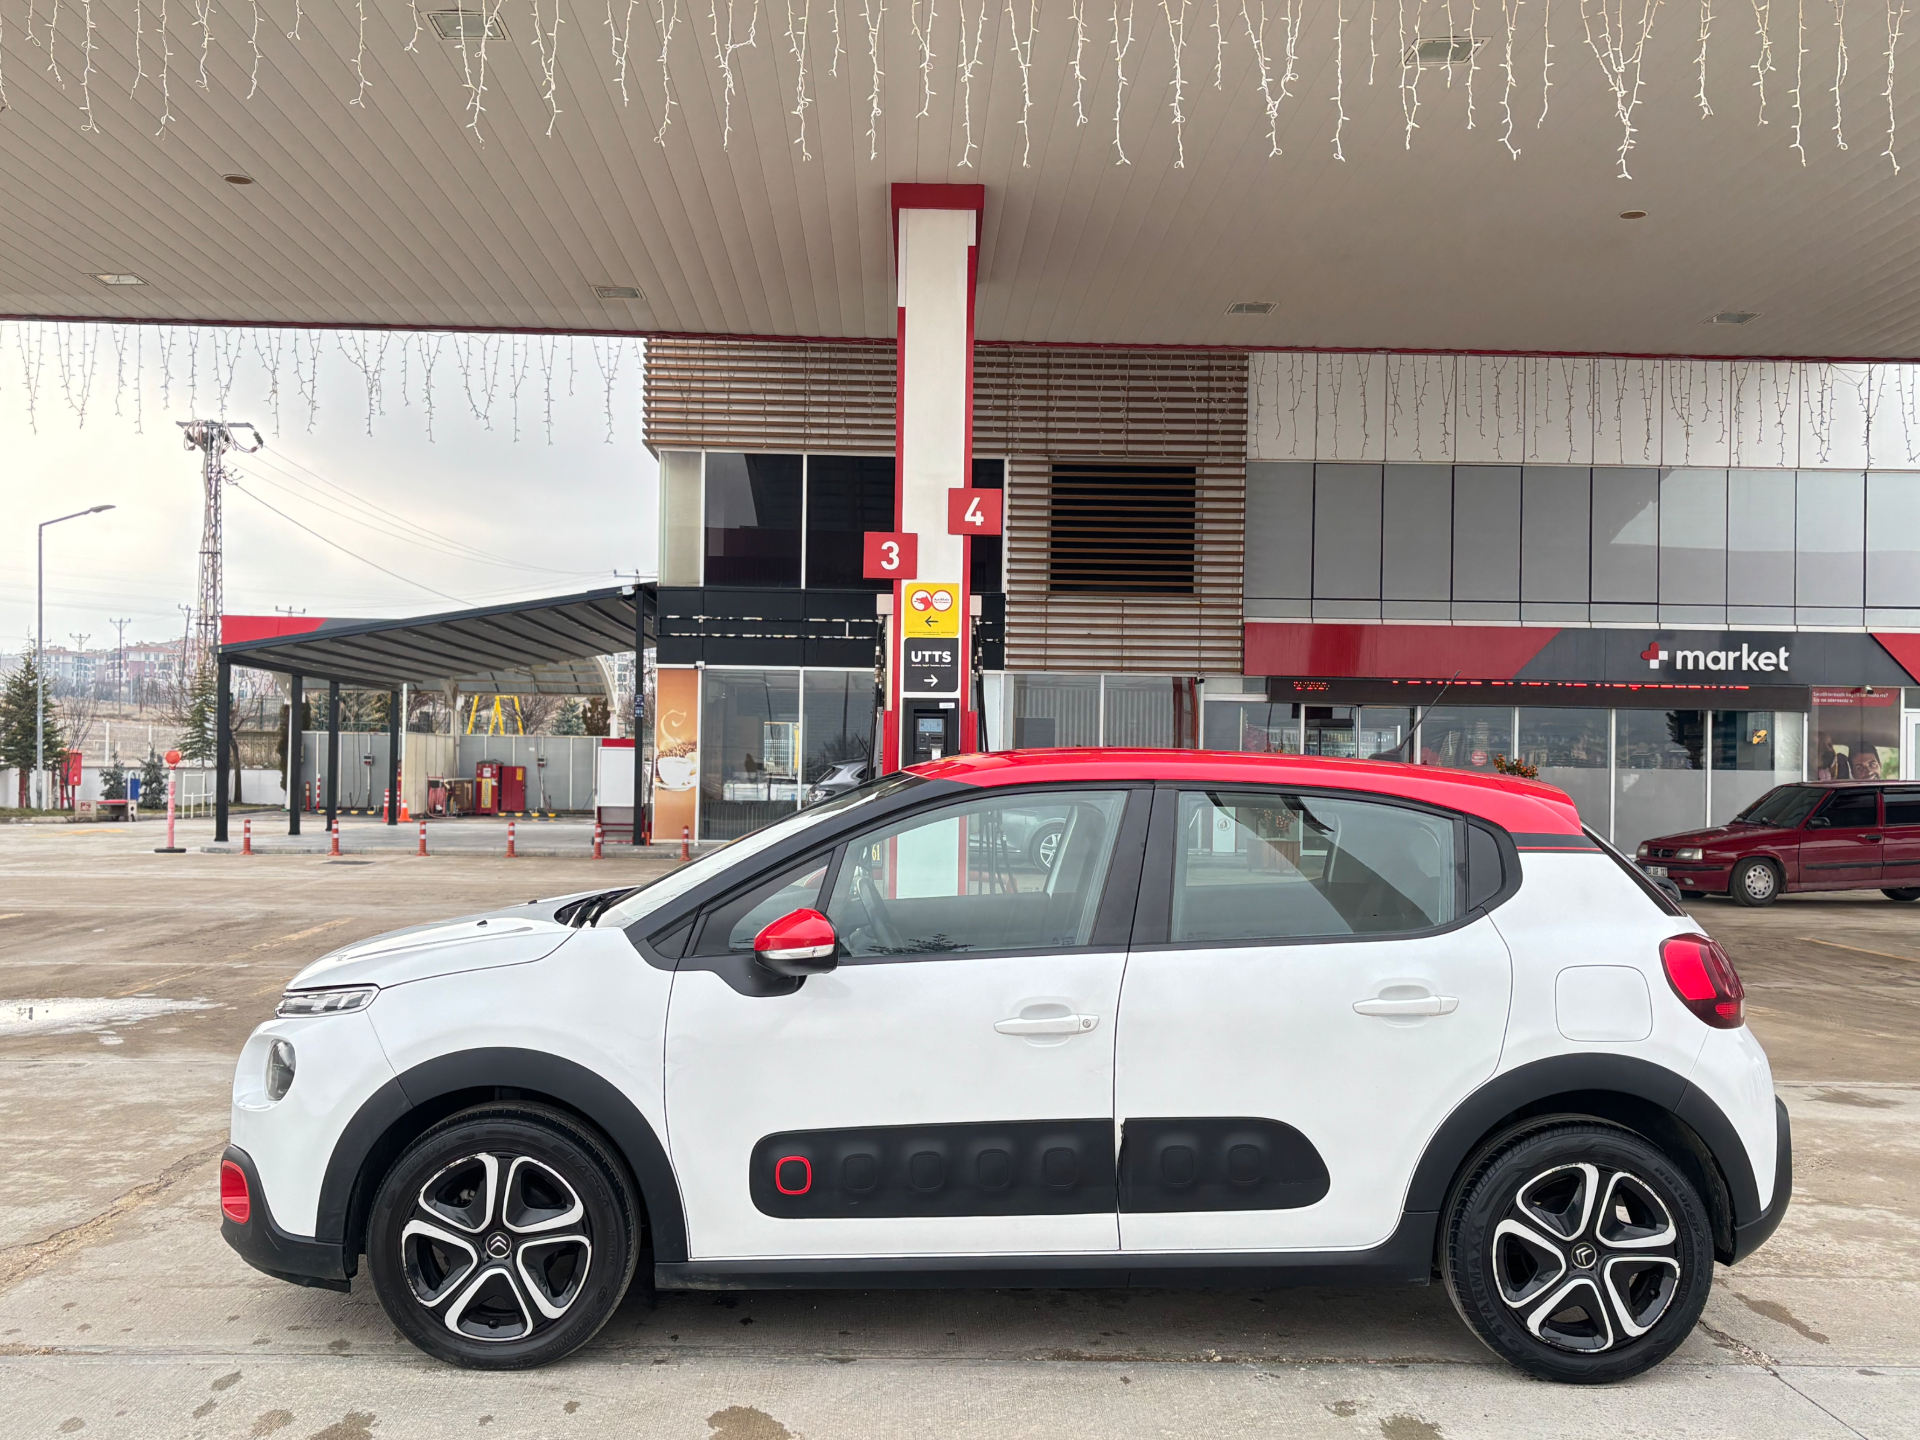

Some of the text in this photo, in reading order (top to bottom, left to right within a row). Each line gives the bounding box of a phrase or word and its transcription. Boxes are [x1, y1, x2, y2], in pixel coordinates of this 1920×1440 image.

[964, 497, 984, 526] 4
[880, 541, 900, 571] 3
[911, 651, 952, 663] UTTS
[1676, 643, 1790, 672] market
[871, 844, 881, 861] 61
[1466, 1222, 1508, 1338] STARMAXX
